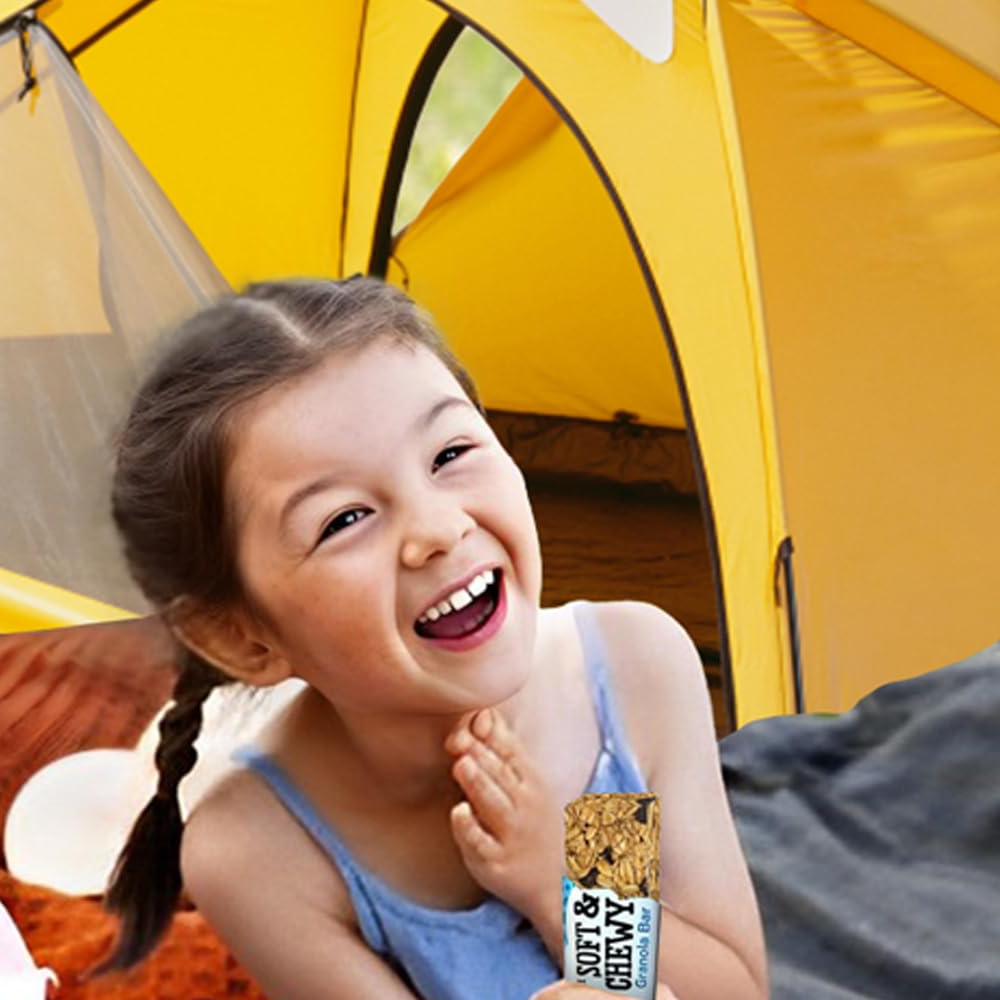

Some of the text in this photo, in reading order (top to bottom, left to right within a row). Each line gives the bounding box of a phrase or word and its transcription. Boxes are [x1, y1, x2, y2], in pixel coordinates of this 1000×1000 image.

[574, 893, 601, 977] SOFT &
[605, 897, 634, 990] CHEWY
[635, 907, 652, 989] Granola Bar
